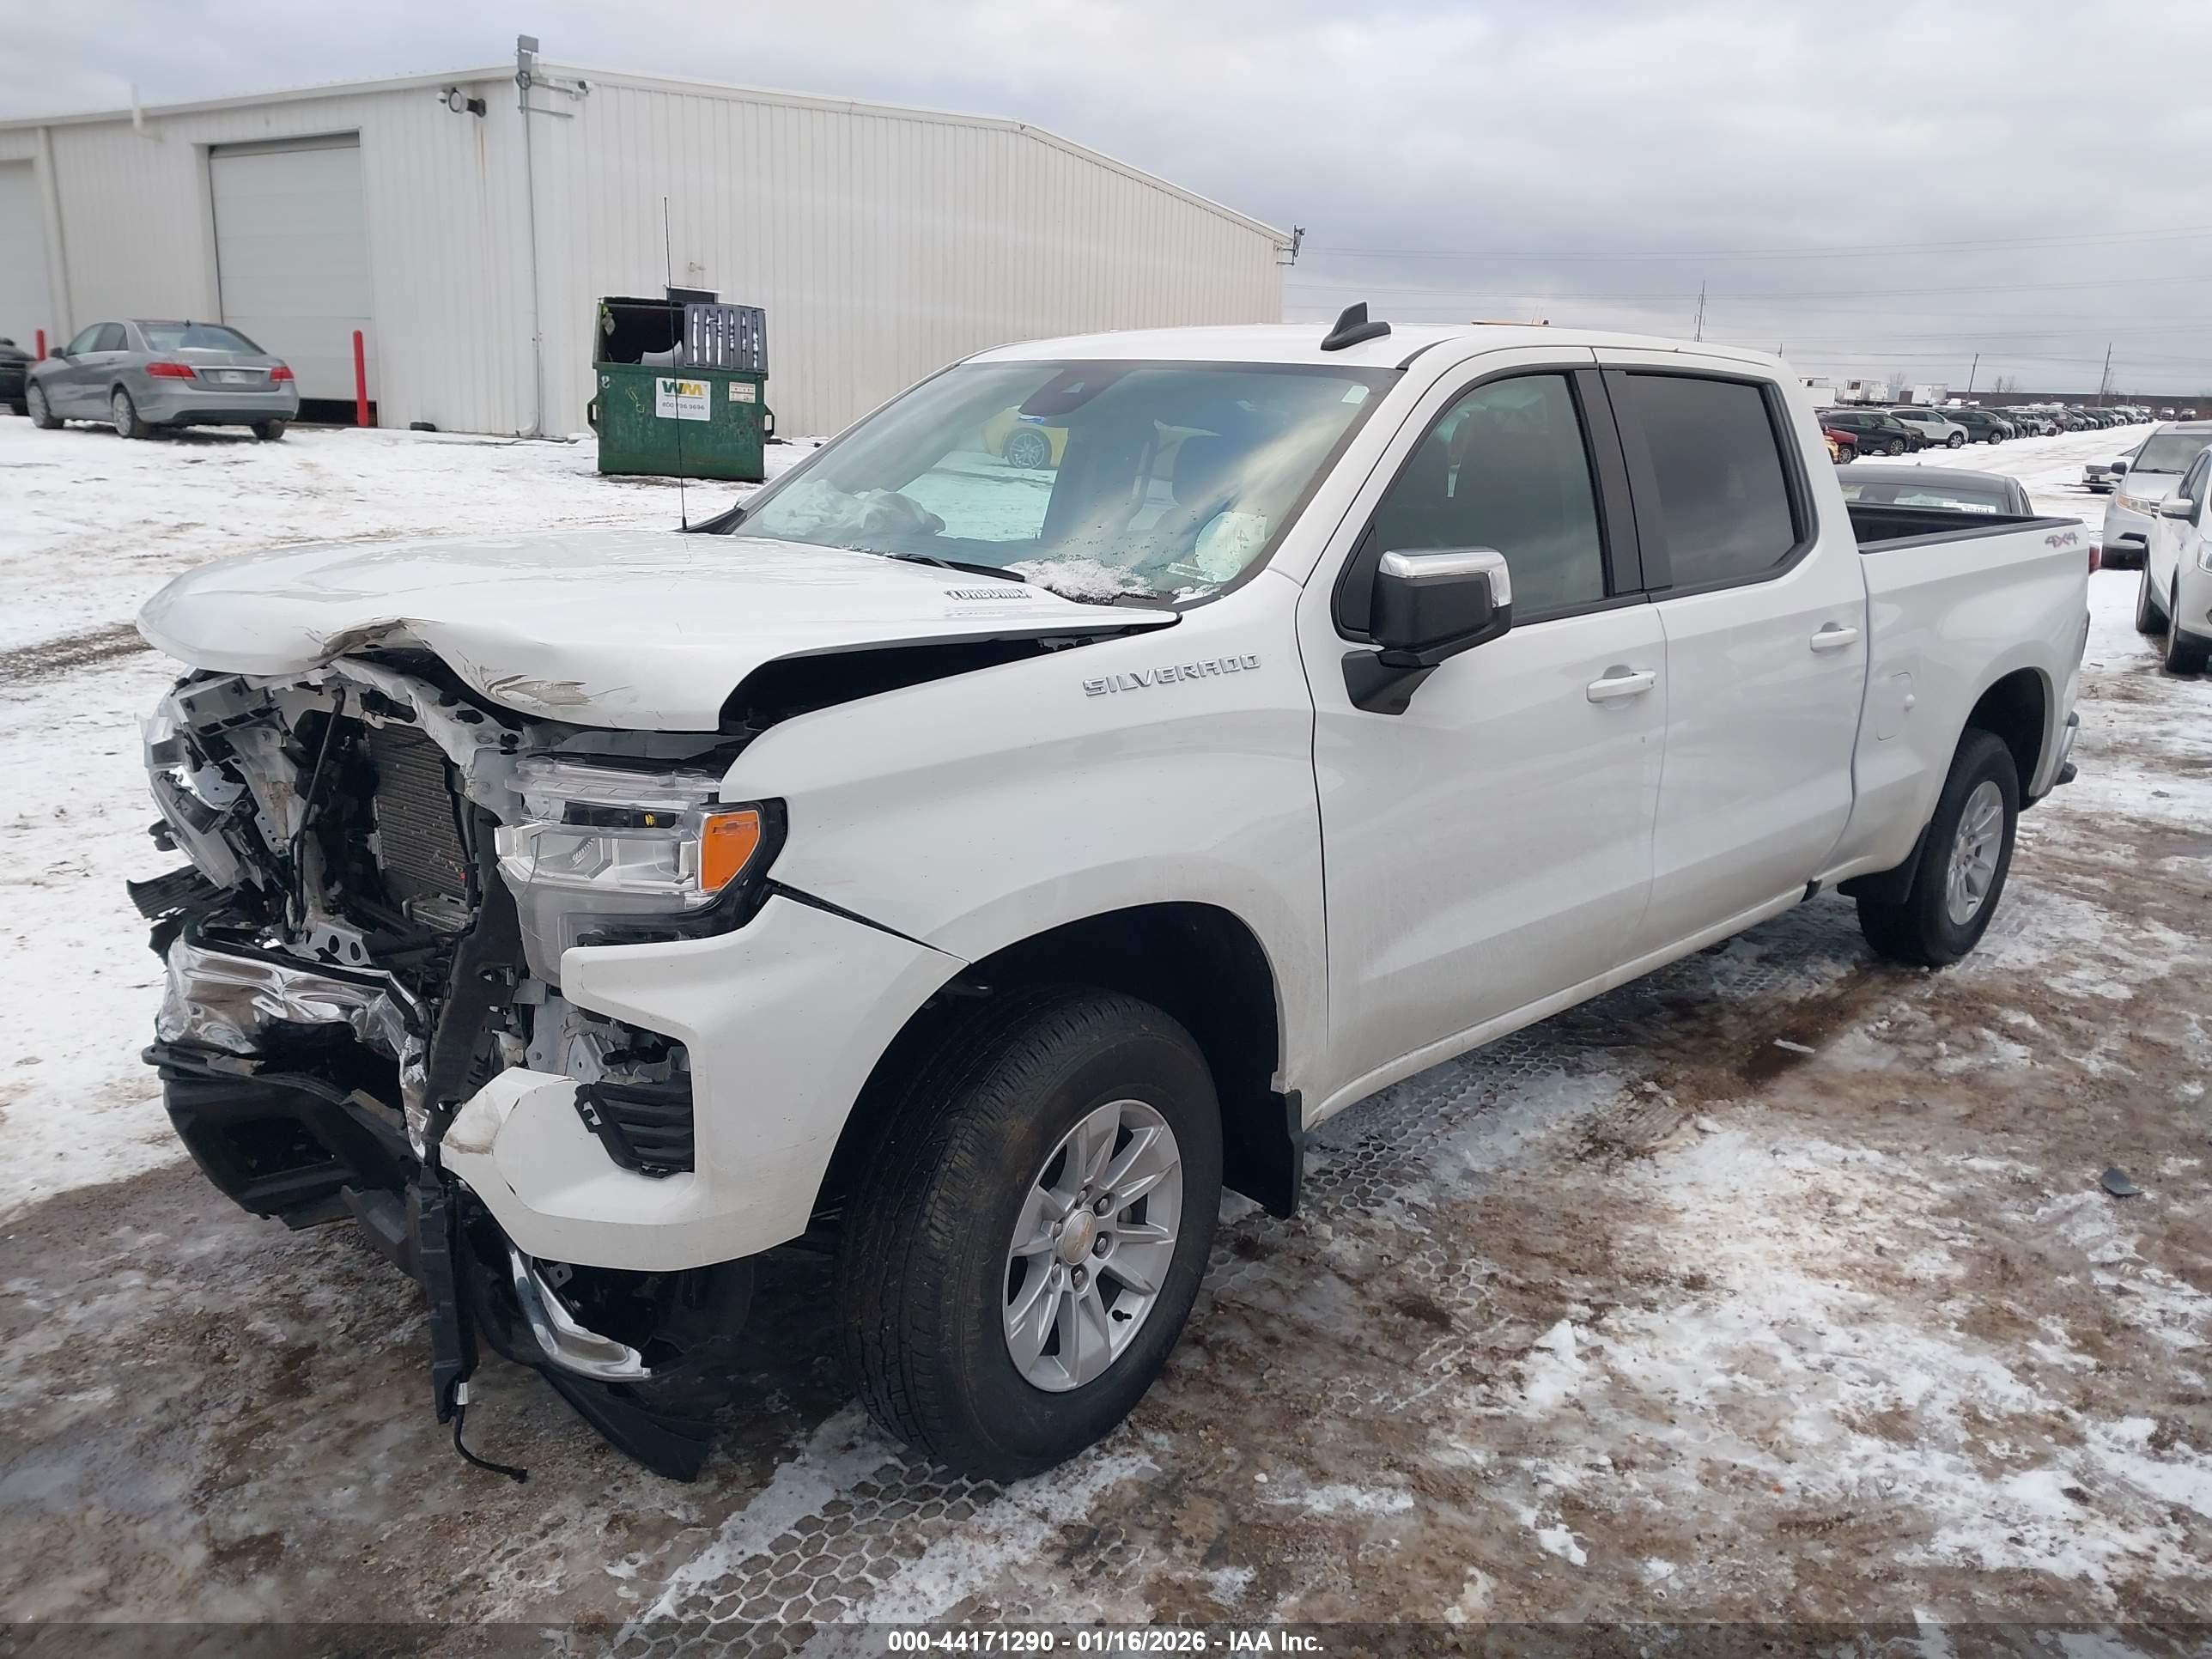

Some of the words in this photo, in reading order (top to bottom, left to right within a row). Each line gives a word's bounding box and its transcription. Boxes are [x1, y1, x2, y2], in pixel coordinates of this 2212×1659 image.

[662, 380, 702, 395] WM
[944, 588, 1033, 600] TURBOMAX
[1083, 653, 1261, 696] SILVERADO
